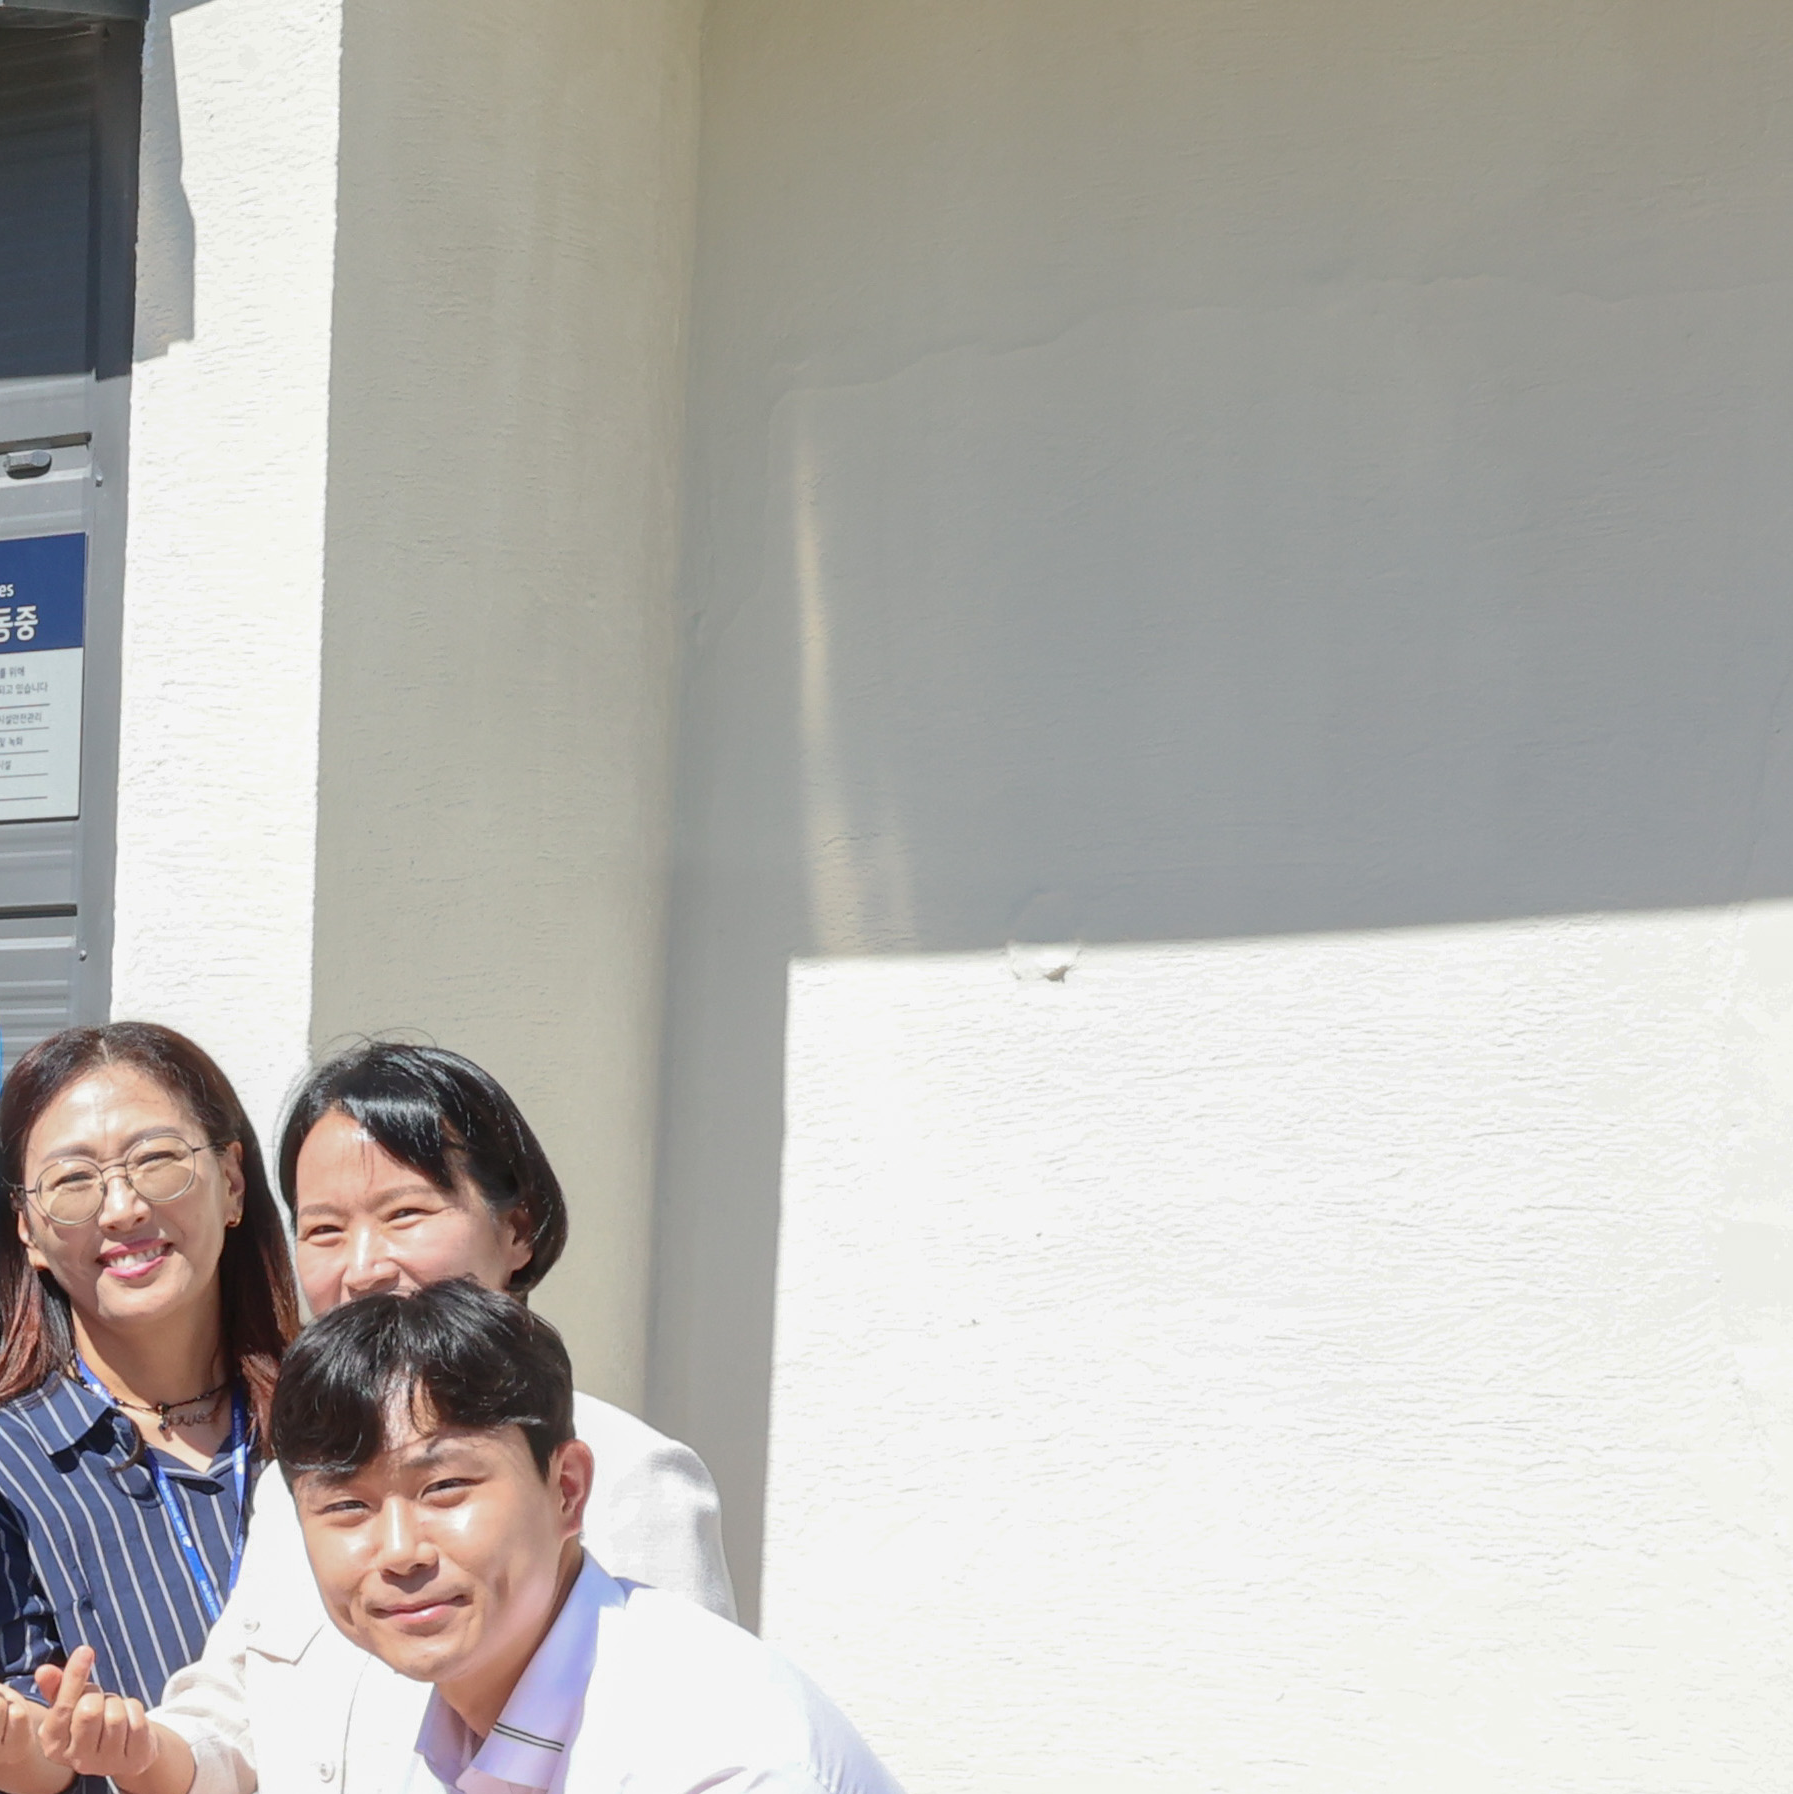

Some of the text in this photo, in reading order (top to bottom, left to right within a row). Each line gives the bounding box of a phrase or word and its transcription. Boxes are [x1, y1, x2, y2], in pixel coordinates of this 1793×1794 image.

[9, 665, 26, 678] 위해
[15, 681, 49, 695] 있습니다
[7, 736, 24, 747] 녹화
